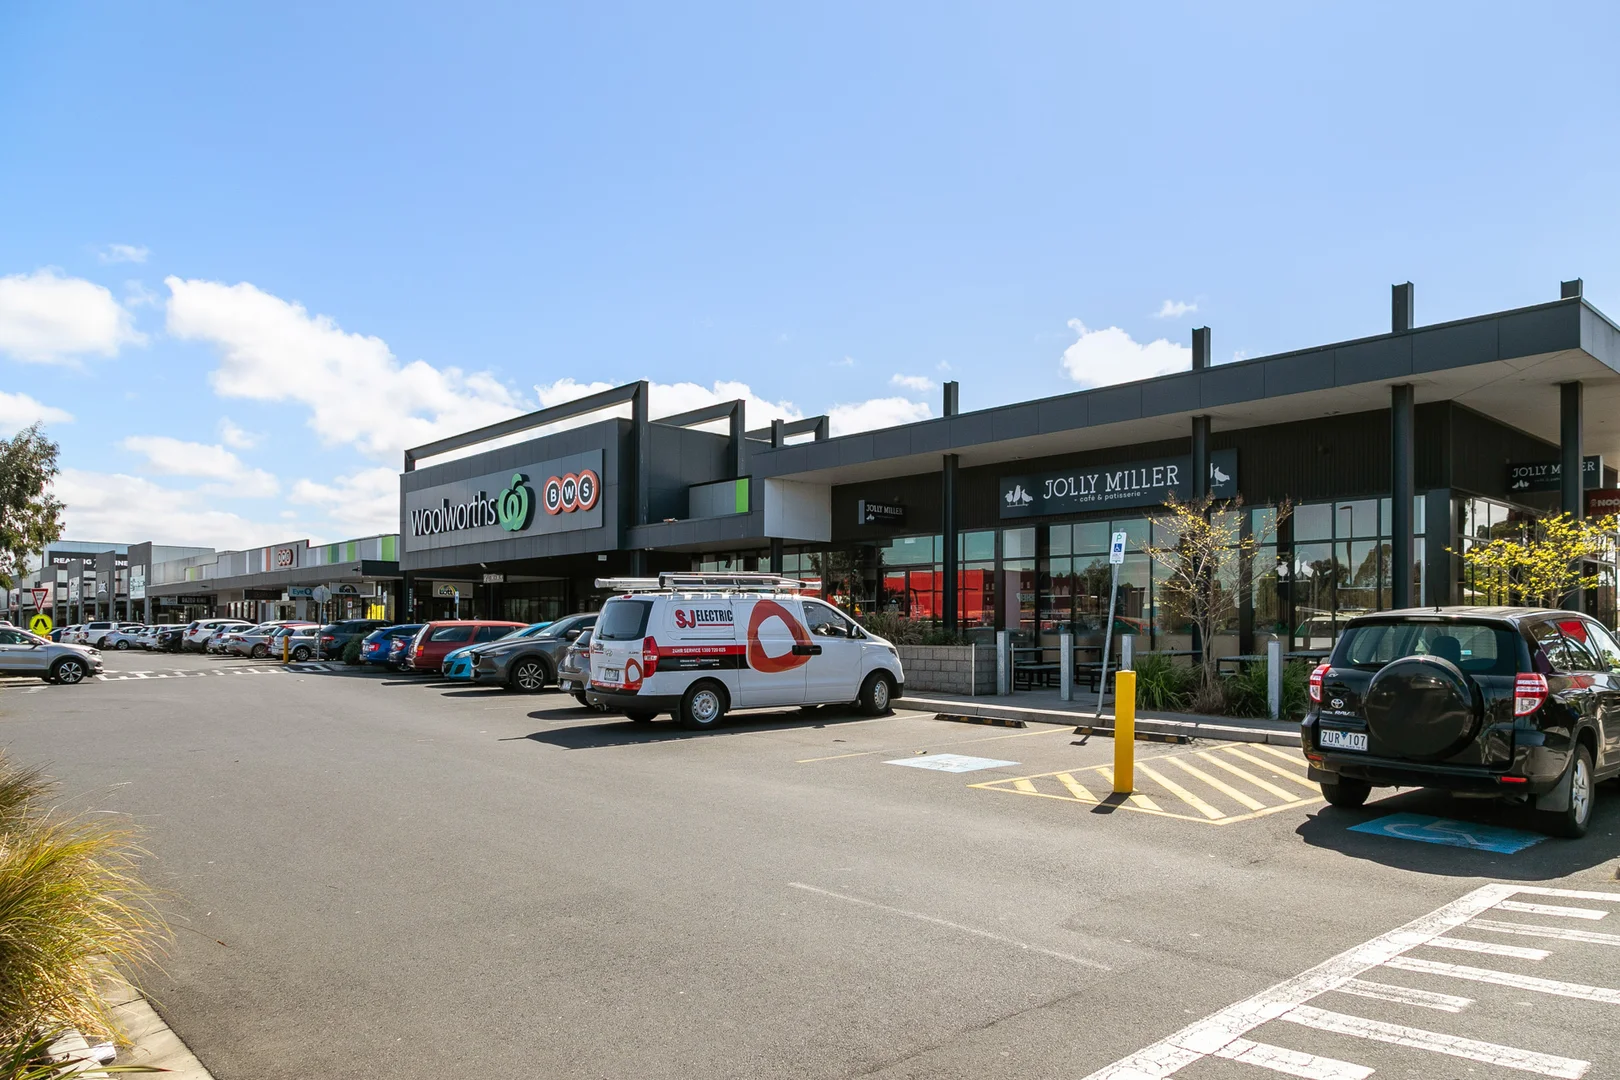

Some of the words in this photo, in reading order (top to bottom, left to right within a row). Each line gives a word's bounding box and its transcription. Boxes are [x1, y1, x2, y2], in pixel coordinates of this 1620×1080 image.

[1512, 466, 1547, 478] JOLLY
[1551, 461, 1595, 474] MER
[1043, 474, 1099, 499] JOLLY
[1105, 465, 1180, 492] MILLER
[1097, 493, 1103, 501] &
[1104, 490, 1141, 501] patisserie
[866, 504, 883, 513] JOLLY
[883, 506, 904, 515] MILLER
[675, 609, 696, 629] SJ
[696, 609, 733, 622] ELECTRIC
[1322, 731, 1341, 744] ZUR
[1349, 734, 1366, 747] 107
